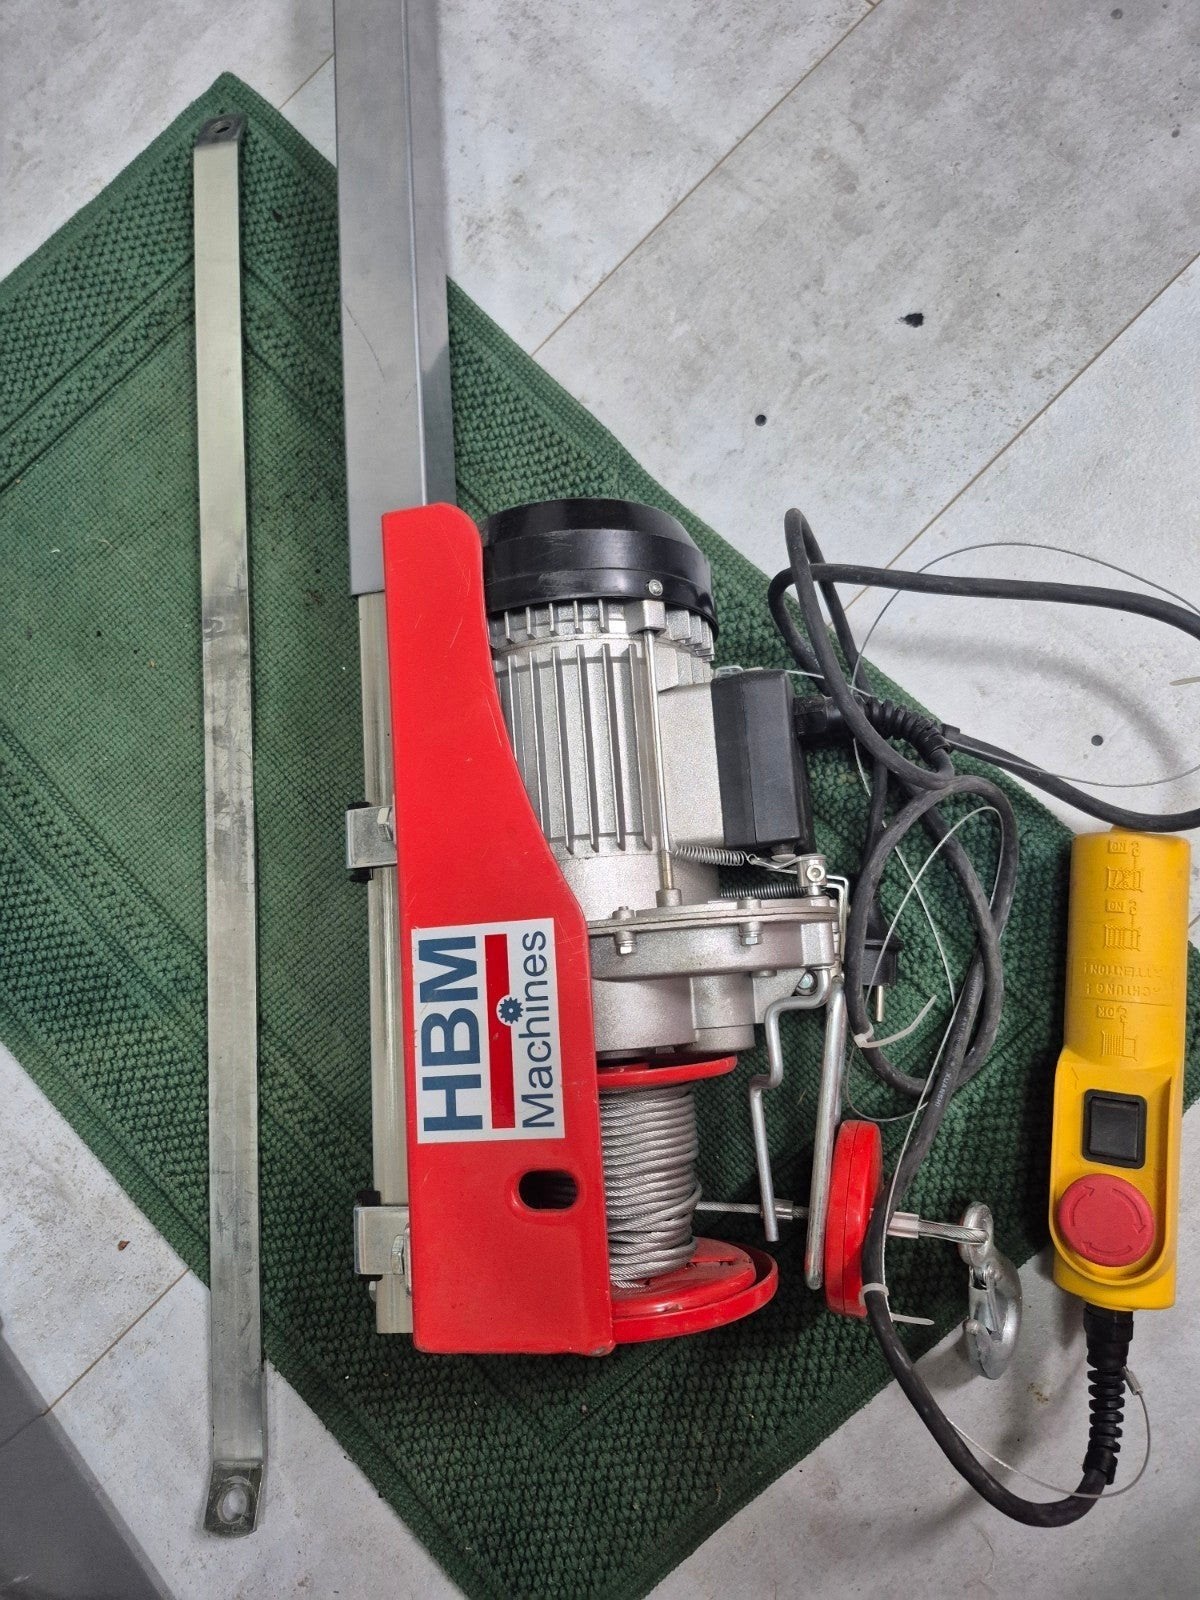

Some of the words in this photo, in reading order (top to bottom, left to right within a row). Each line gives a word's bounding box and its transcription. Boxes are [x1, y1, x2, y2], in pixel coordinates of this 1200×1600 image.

[1109, 901, 1124, 912] NO
[418, 935, 484, 1132] HBM
[518, 930, 555, 1129] Machines
[1097, 1005, 1115, 1017] OK
